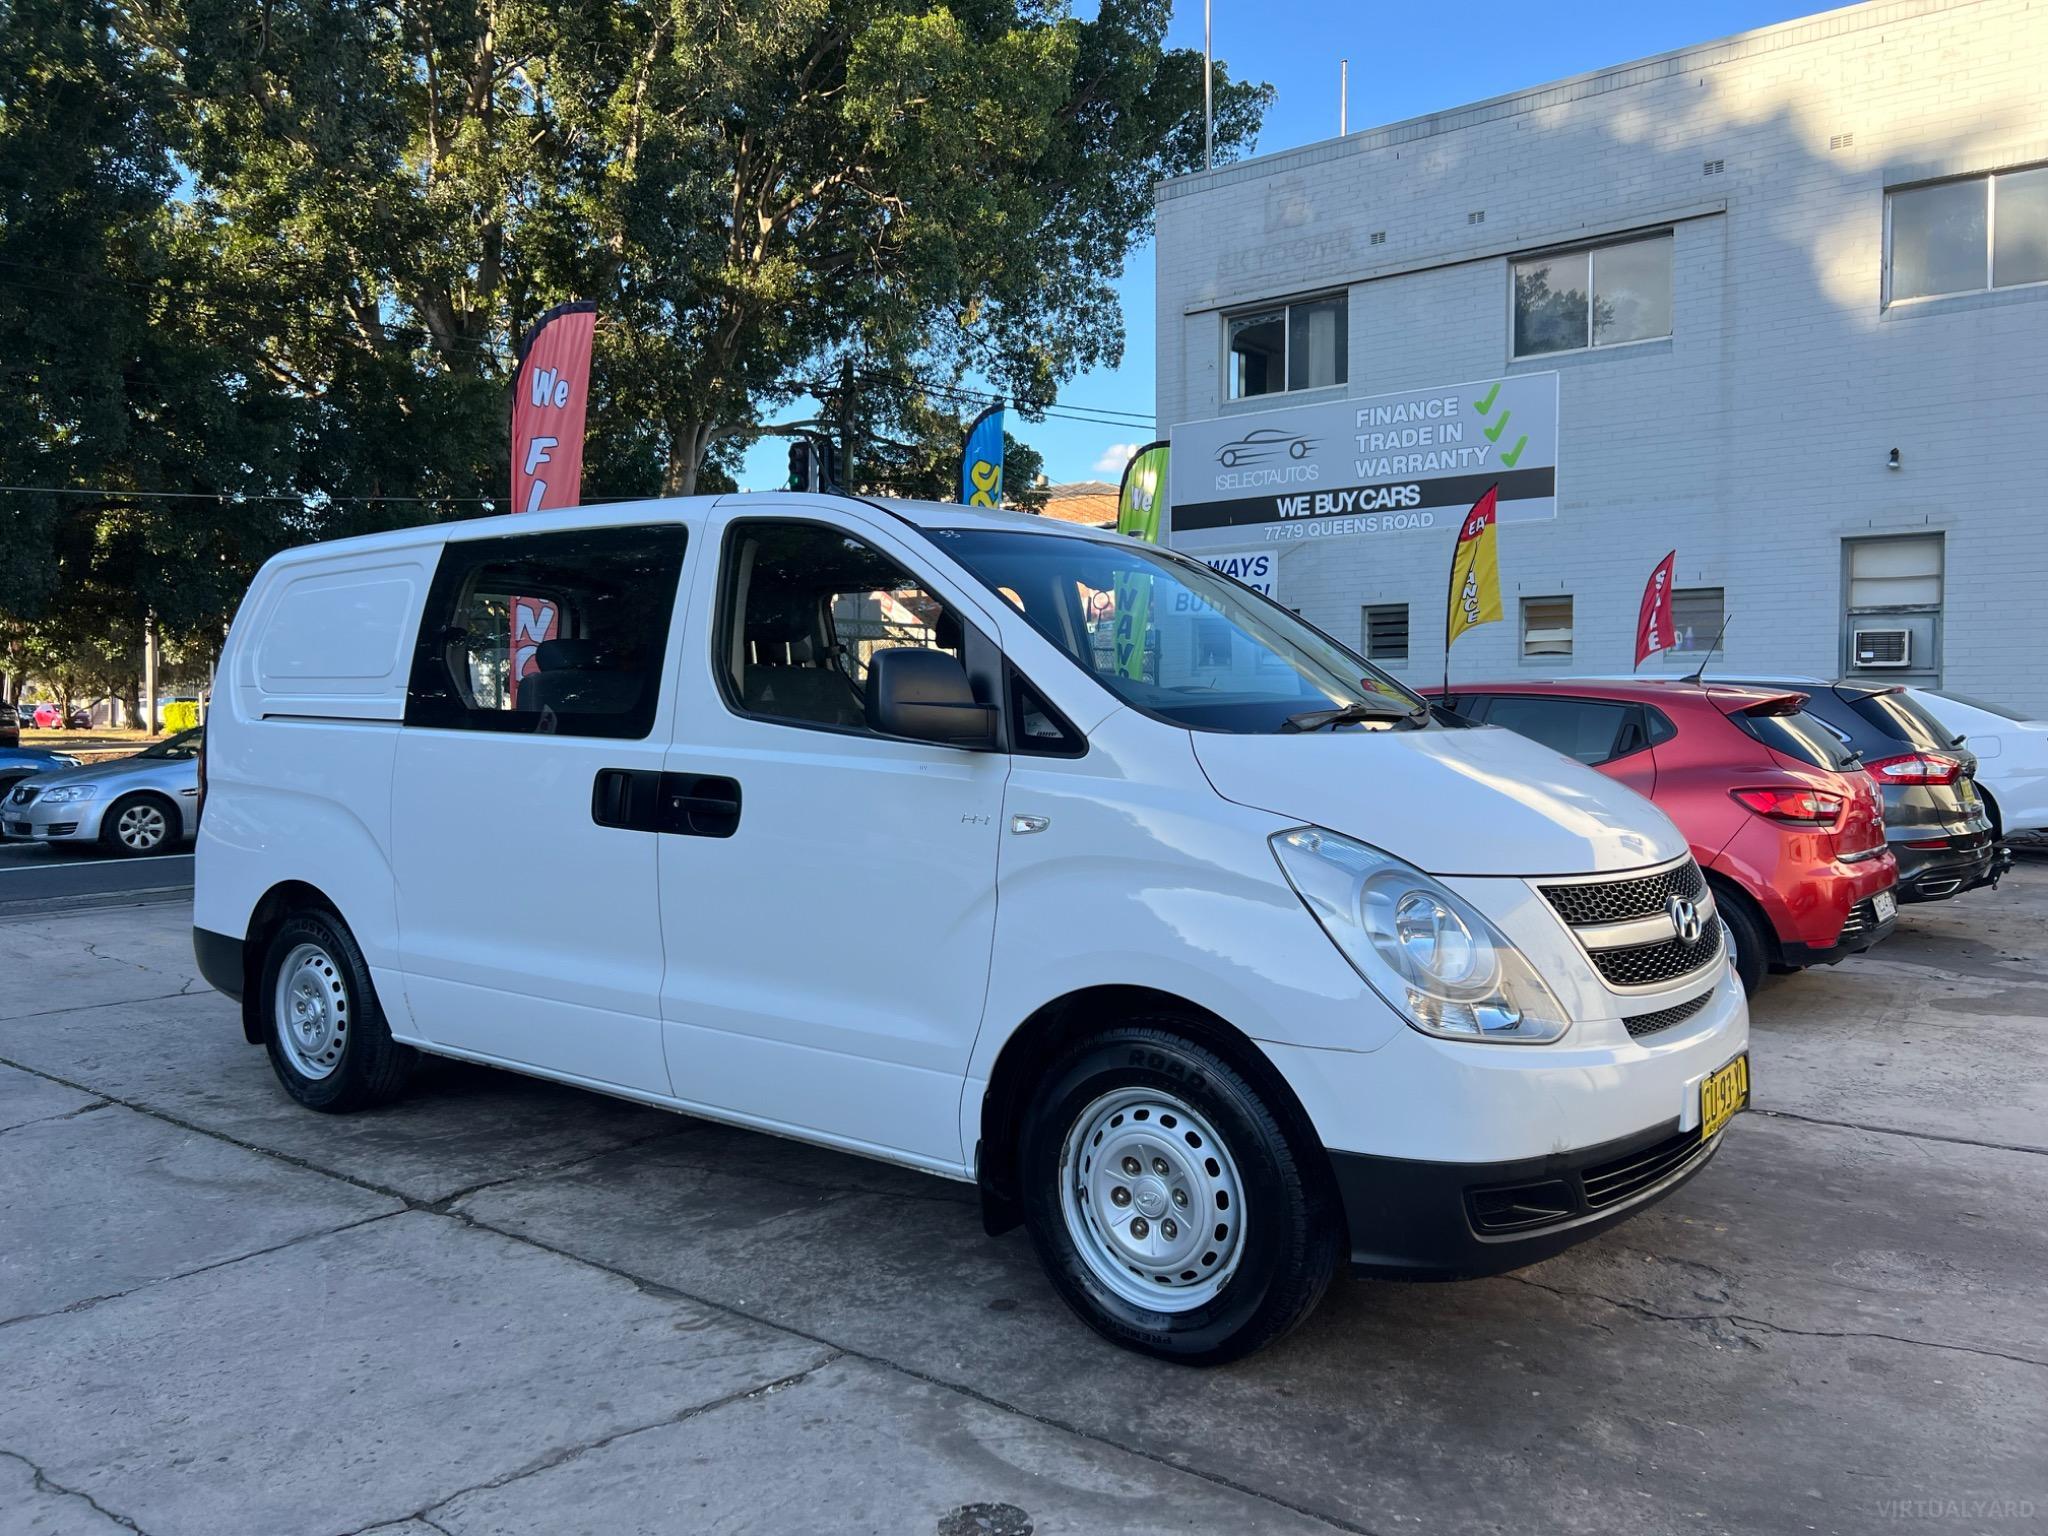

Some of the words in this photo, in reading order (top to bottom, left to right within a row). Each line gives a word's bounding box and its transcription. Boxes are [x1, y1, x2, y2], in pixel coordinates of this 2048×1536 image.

[531, 367, 569, 409] We
[1356, 397, 1459, 428] FINANCE
[1355, 426, 1433, 453] TRADE
[1439, 422, 1463, 443] IN
[1354, 445, 1491, 478] WARRANTY
[1276, 495, 1311, 518] WE
[1315, 490, 1359, 515] BUY
[1359, 484, 1421, 510] CARS
[1264, 523, 1304, 540] 77-79
[1308, 517, 1378, 537] QUEENS
[1382, 512, 1434, 530] ROAD
